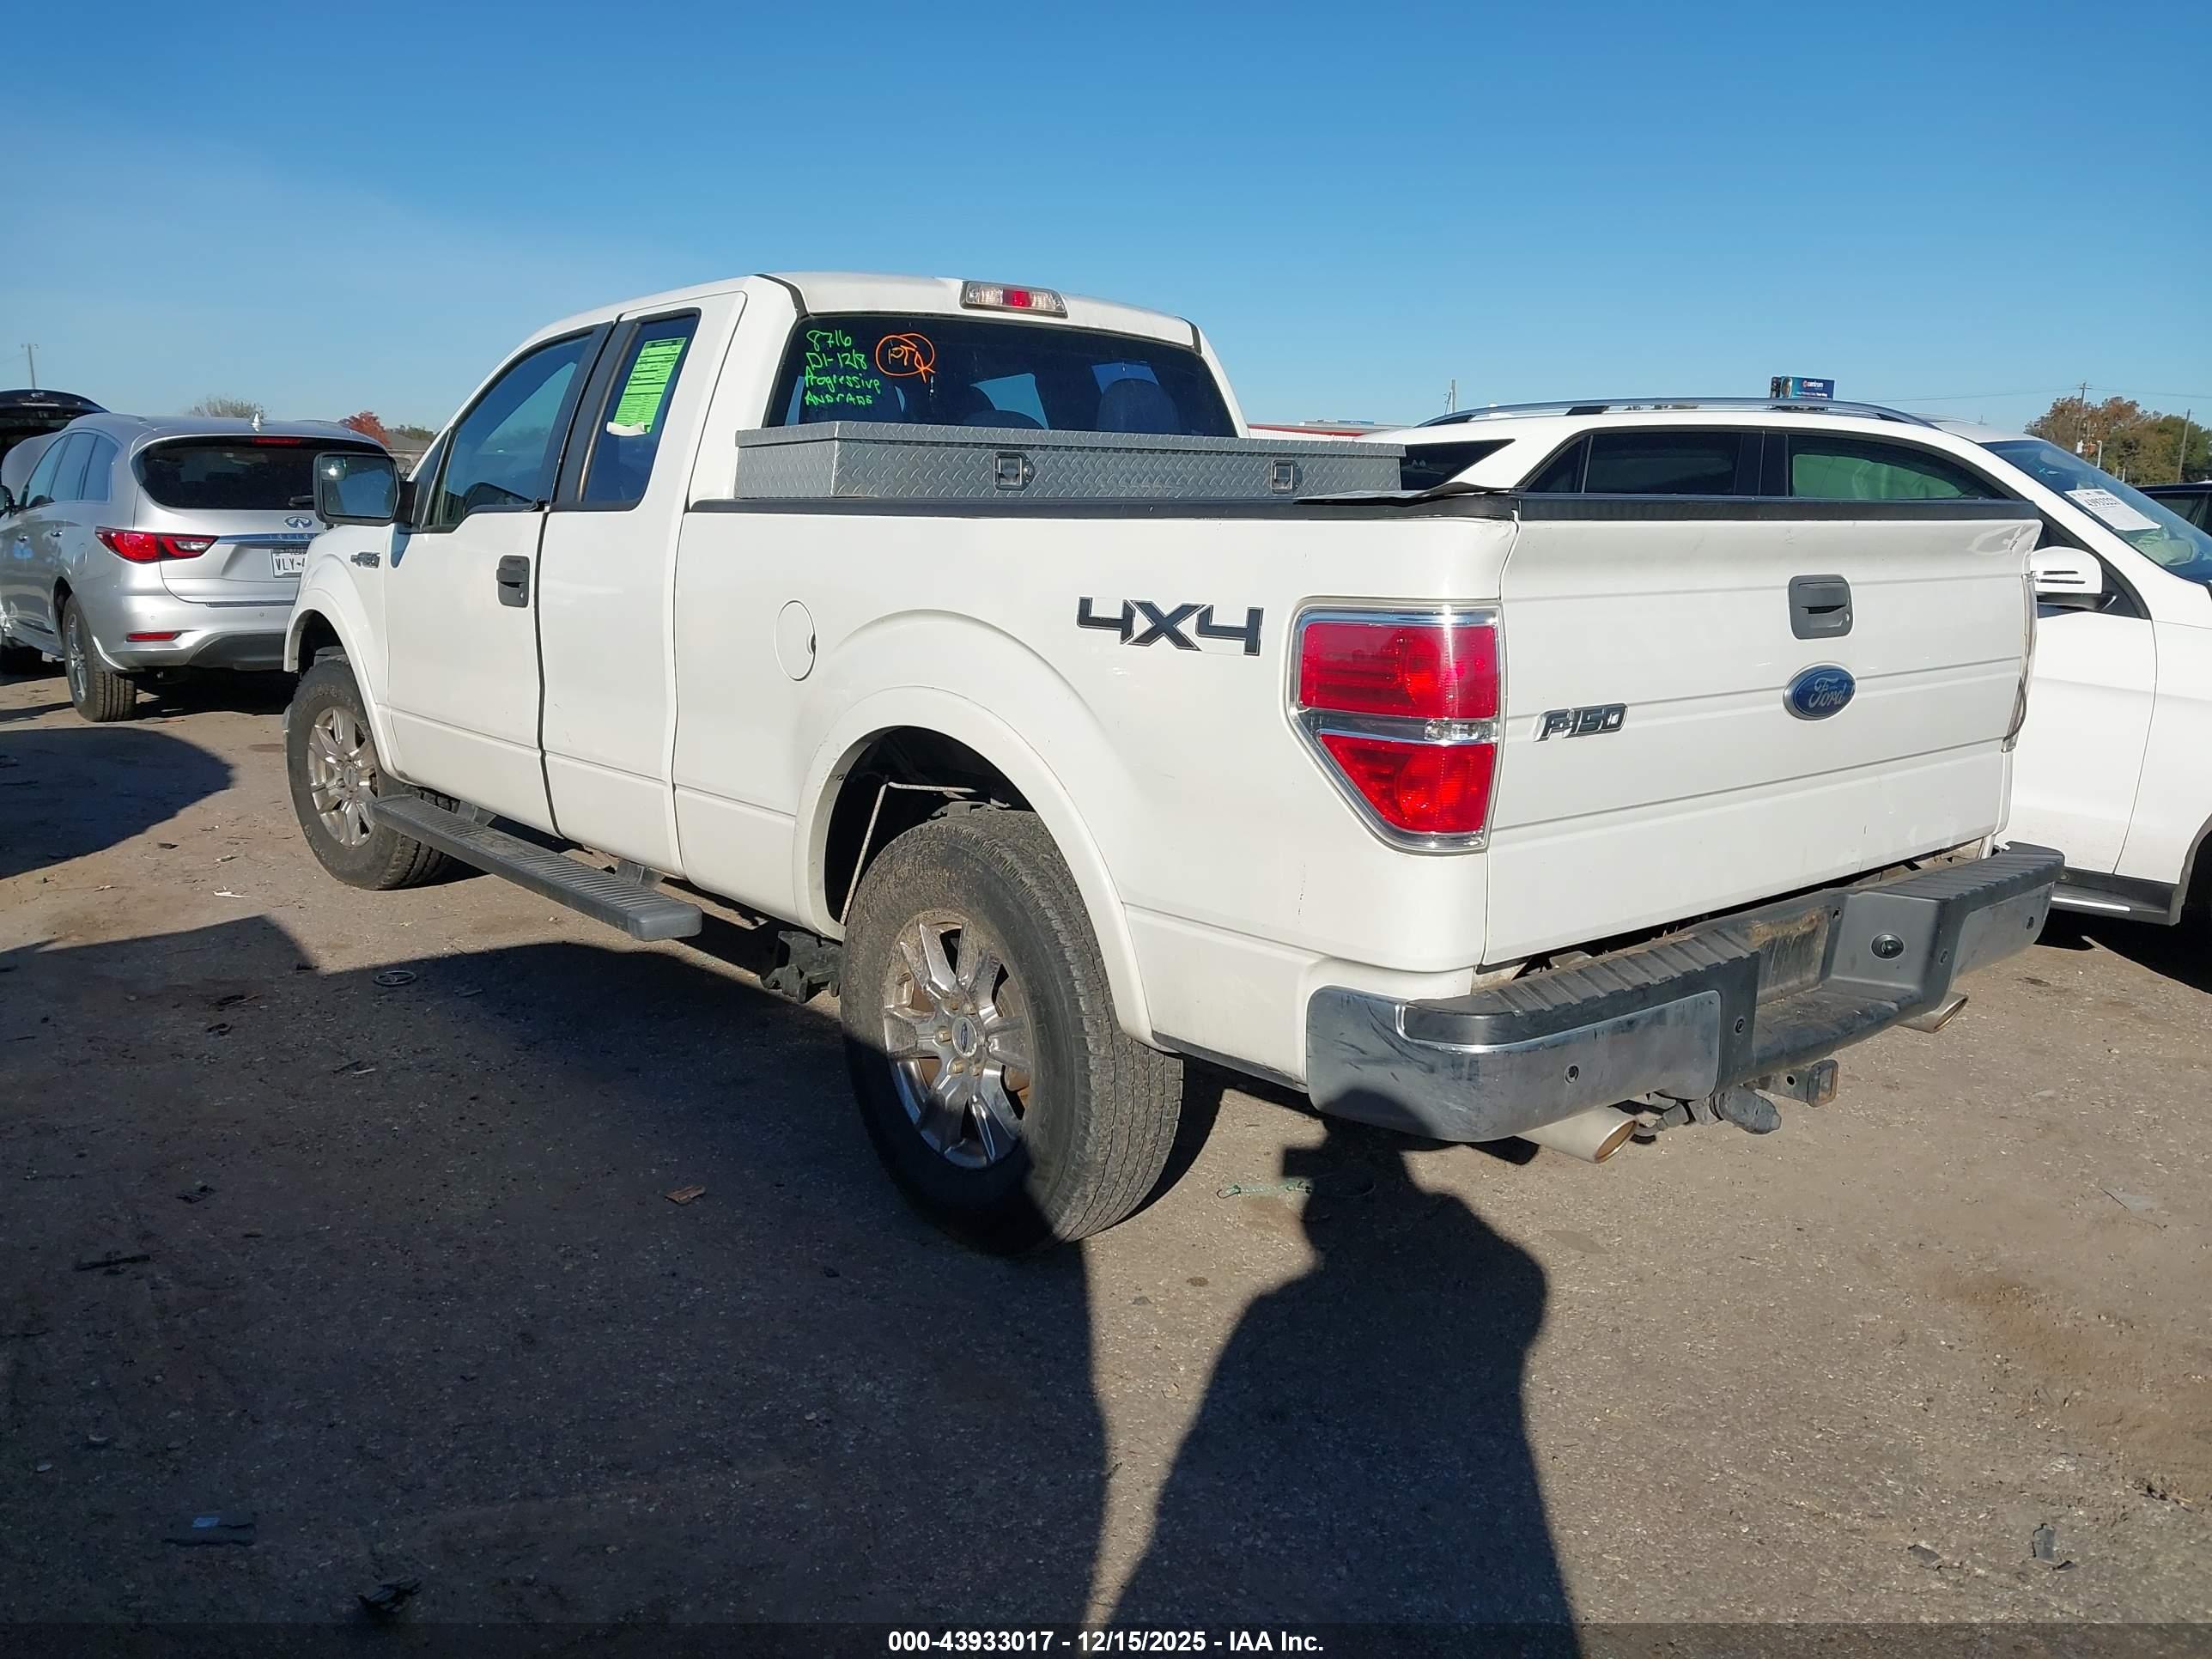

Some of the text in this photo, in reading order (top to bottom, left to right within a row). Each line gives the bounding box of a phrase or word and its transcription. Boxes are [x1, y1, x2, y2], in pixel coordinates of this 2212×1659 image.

[805, 329, 853, 351] 8716
[1808, 677, 1848, 708] Ford
[1534, 702, 1627, 742] F-150
